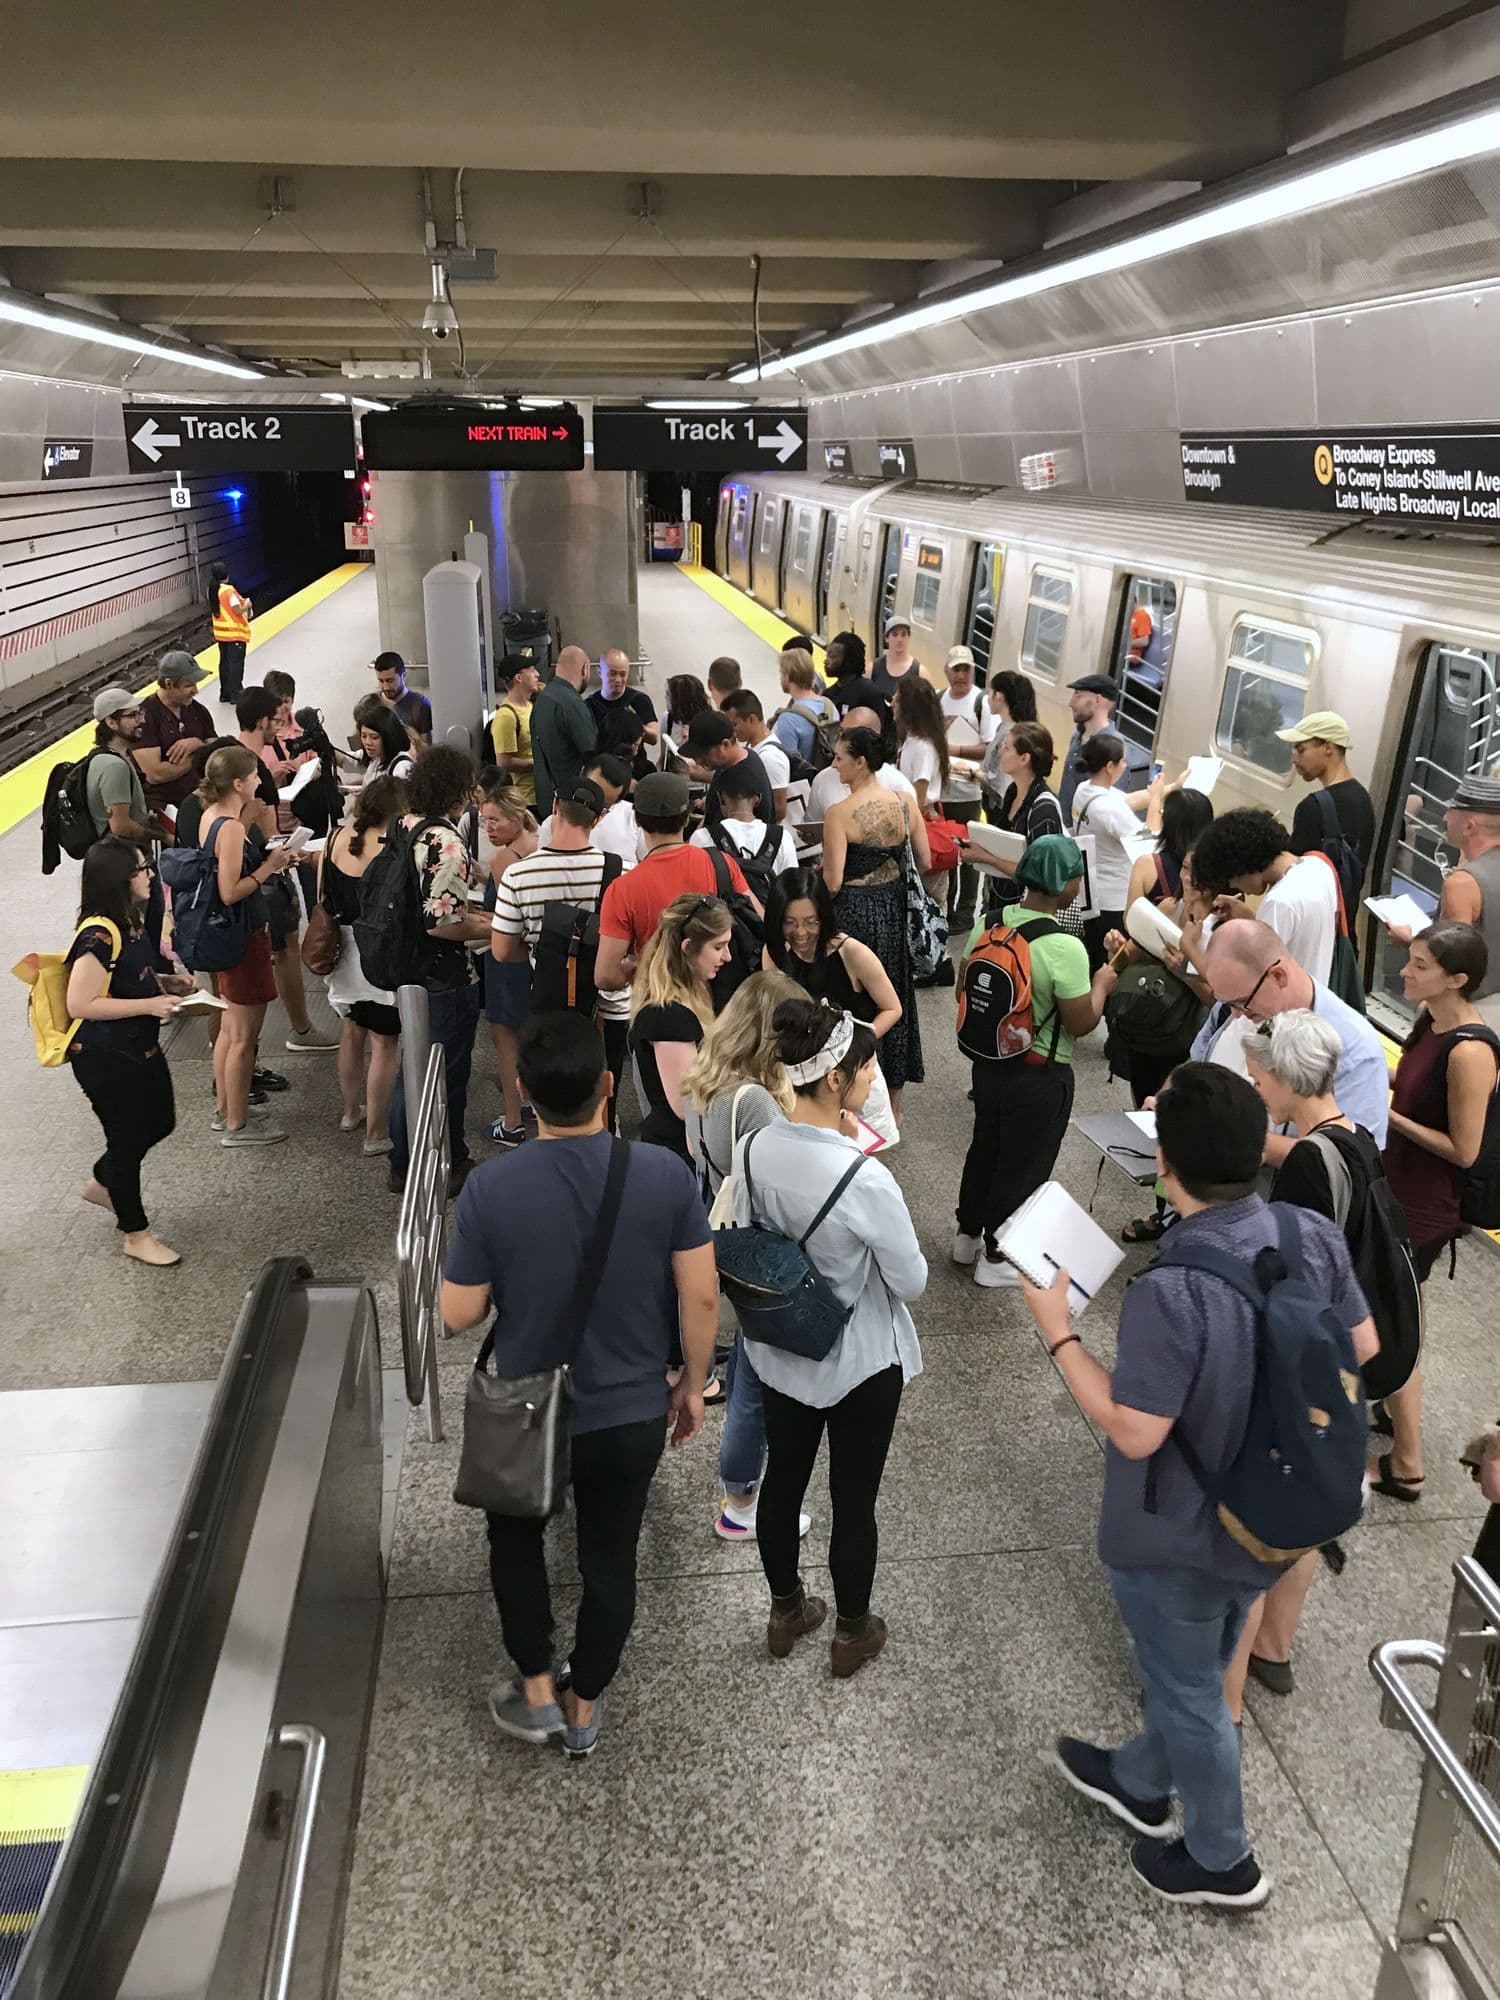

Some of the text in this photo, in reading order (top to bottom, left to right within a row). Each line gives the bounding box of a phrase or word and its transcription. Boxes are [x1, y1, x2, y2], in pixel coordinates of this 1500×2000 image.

[180, 416, 281, 439] Track 2
[468, 426, 547, 440] NEXT TRAIN
[665, 418, 754, 440] Track 1
[1182, 445, 1236, 464] Downtown &
[1318, 454, 1328, 475] Q
[1333, 445, 1436, 468] Broadway Express
[1184, 469, 1221, 491] Brooklyn
[1334, 467, 1500, 492] To Coney Island-Stillwell Ave
[176, 491, 186, 504] 8
[1336, 490, 1500, 520] Late Nights Broadway Local
